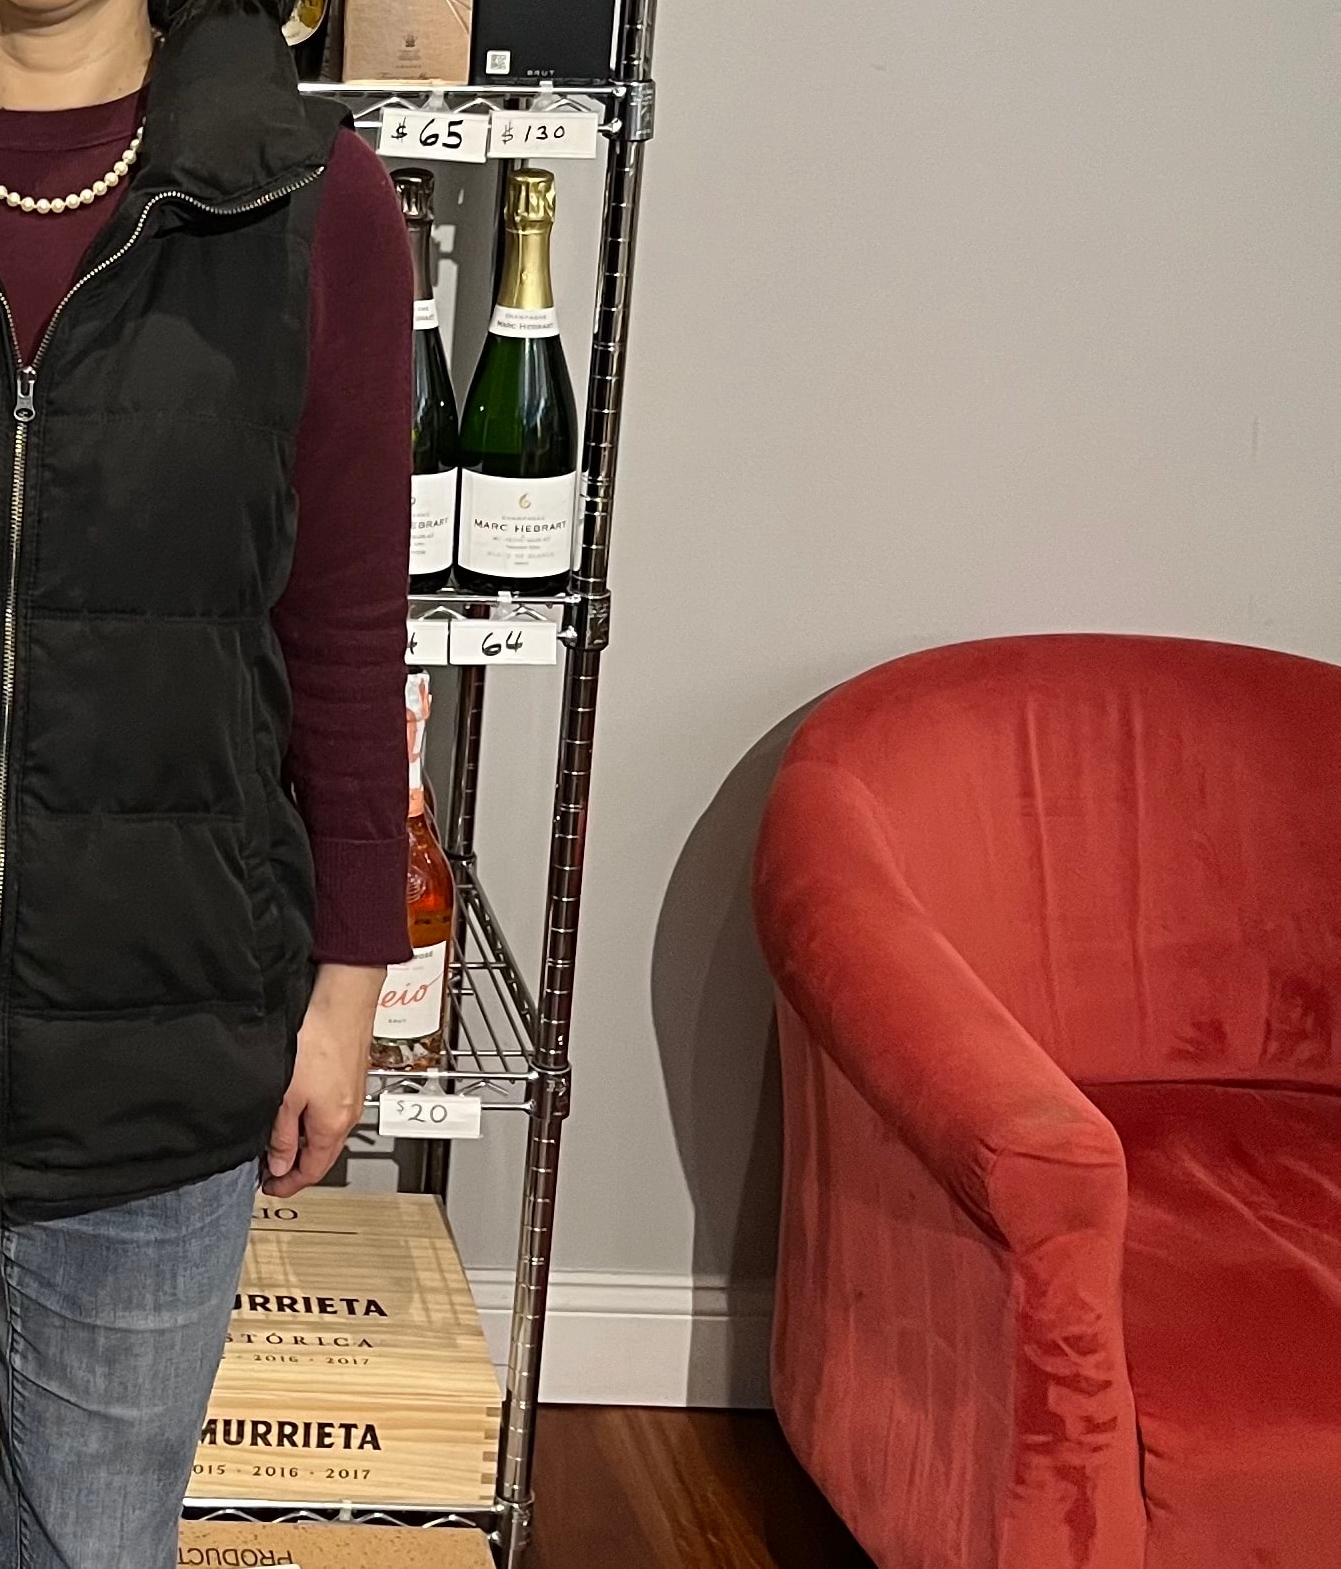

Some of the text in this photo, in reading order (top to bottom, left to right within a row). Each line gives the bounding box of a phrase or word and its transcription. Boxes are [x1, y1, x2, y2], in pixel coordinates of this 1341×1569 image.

[527, 69, 556, 77] BRUT
[473, 518, 568, 533] MARC HEBRART
[481, 630, 524, 657] 64
[396, 1099, 448, 1124] $20
[231, 1293, 389, 1318] RRIETA
[253, 1353, 371, 1367] 2016 2017
[252, 1464, 299, 1479] 2016
[325, 1467, 372, 1482] 2017
